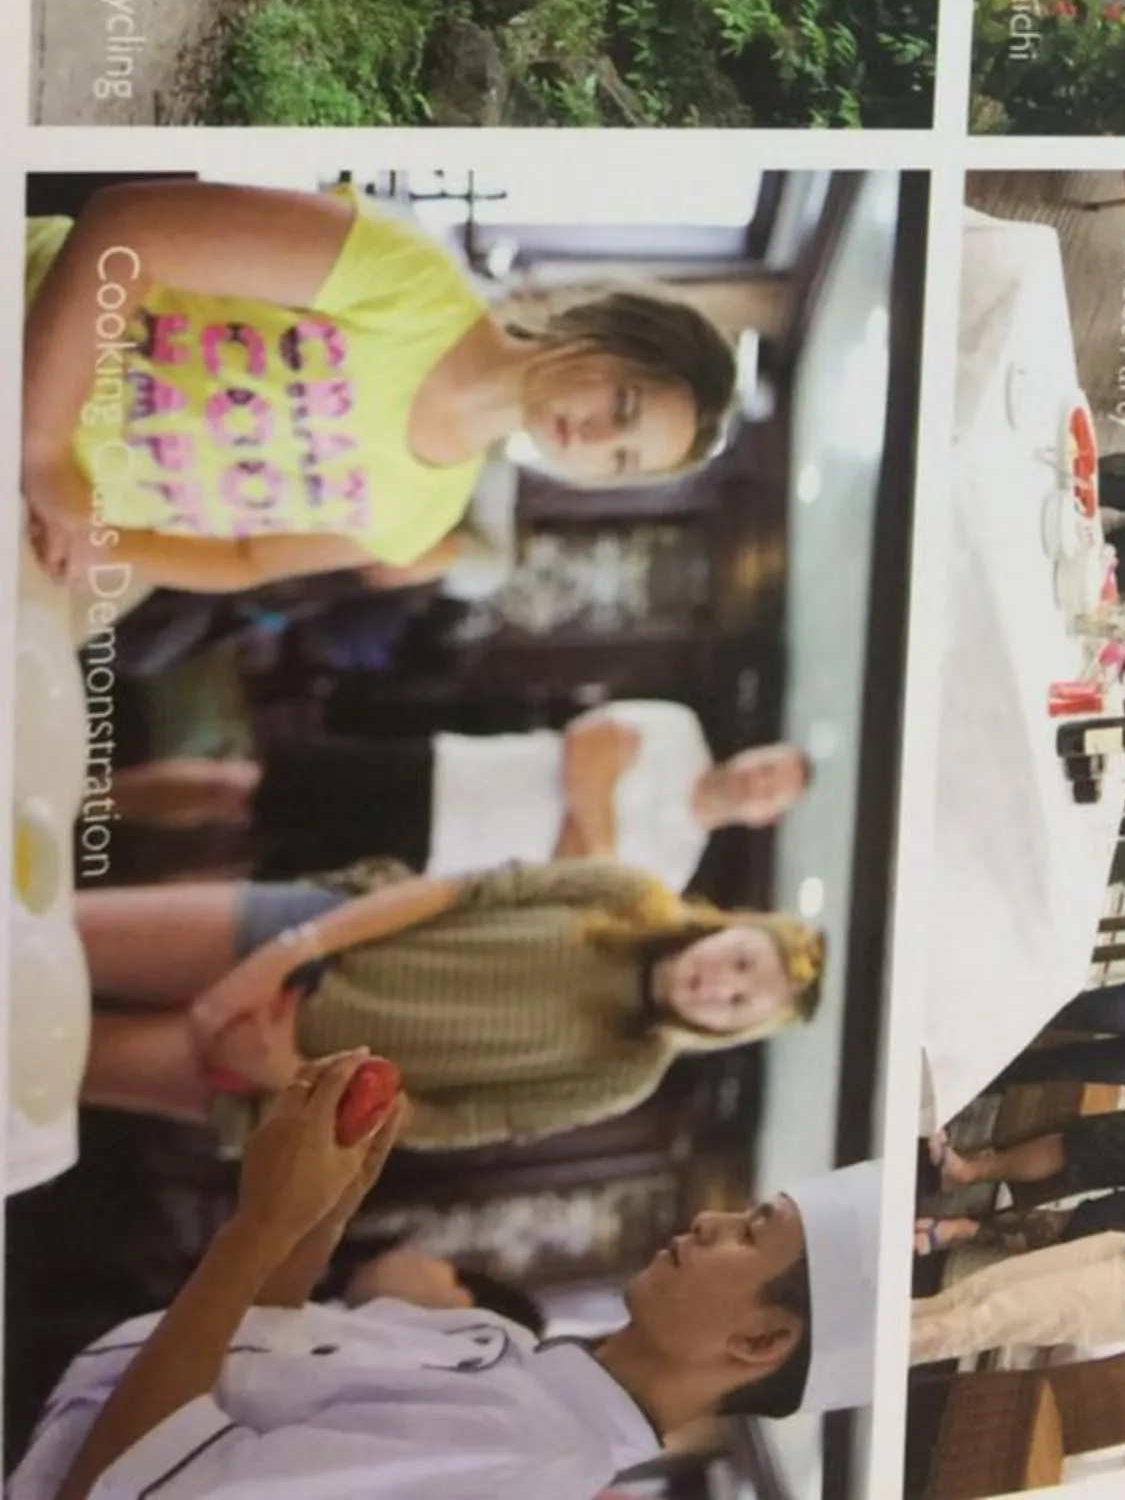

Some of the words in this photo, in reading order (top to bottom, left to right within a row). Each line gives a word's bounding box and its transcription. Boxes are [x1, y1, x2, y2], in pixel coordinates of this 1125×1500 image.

[80, 246, 141, 427] Cooking
[90, 439, 135, 547] Css
[81, 563, 132, 877] Demonstration
